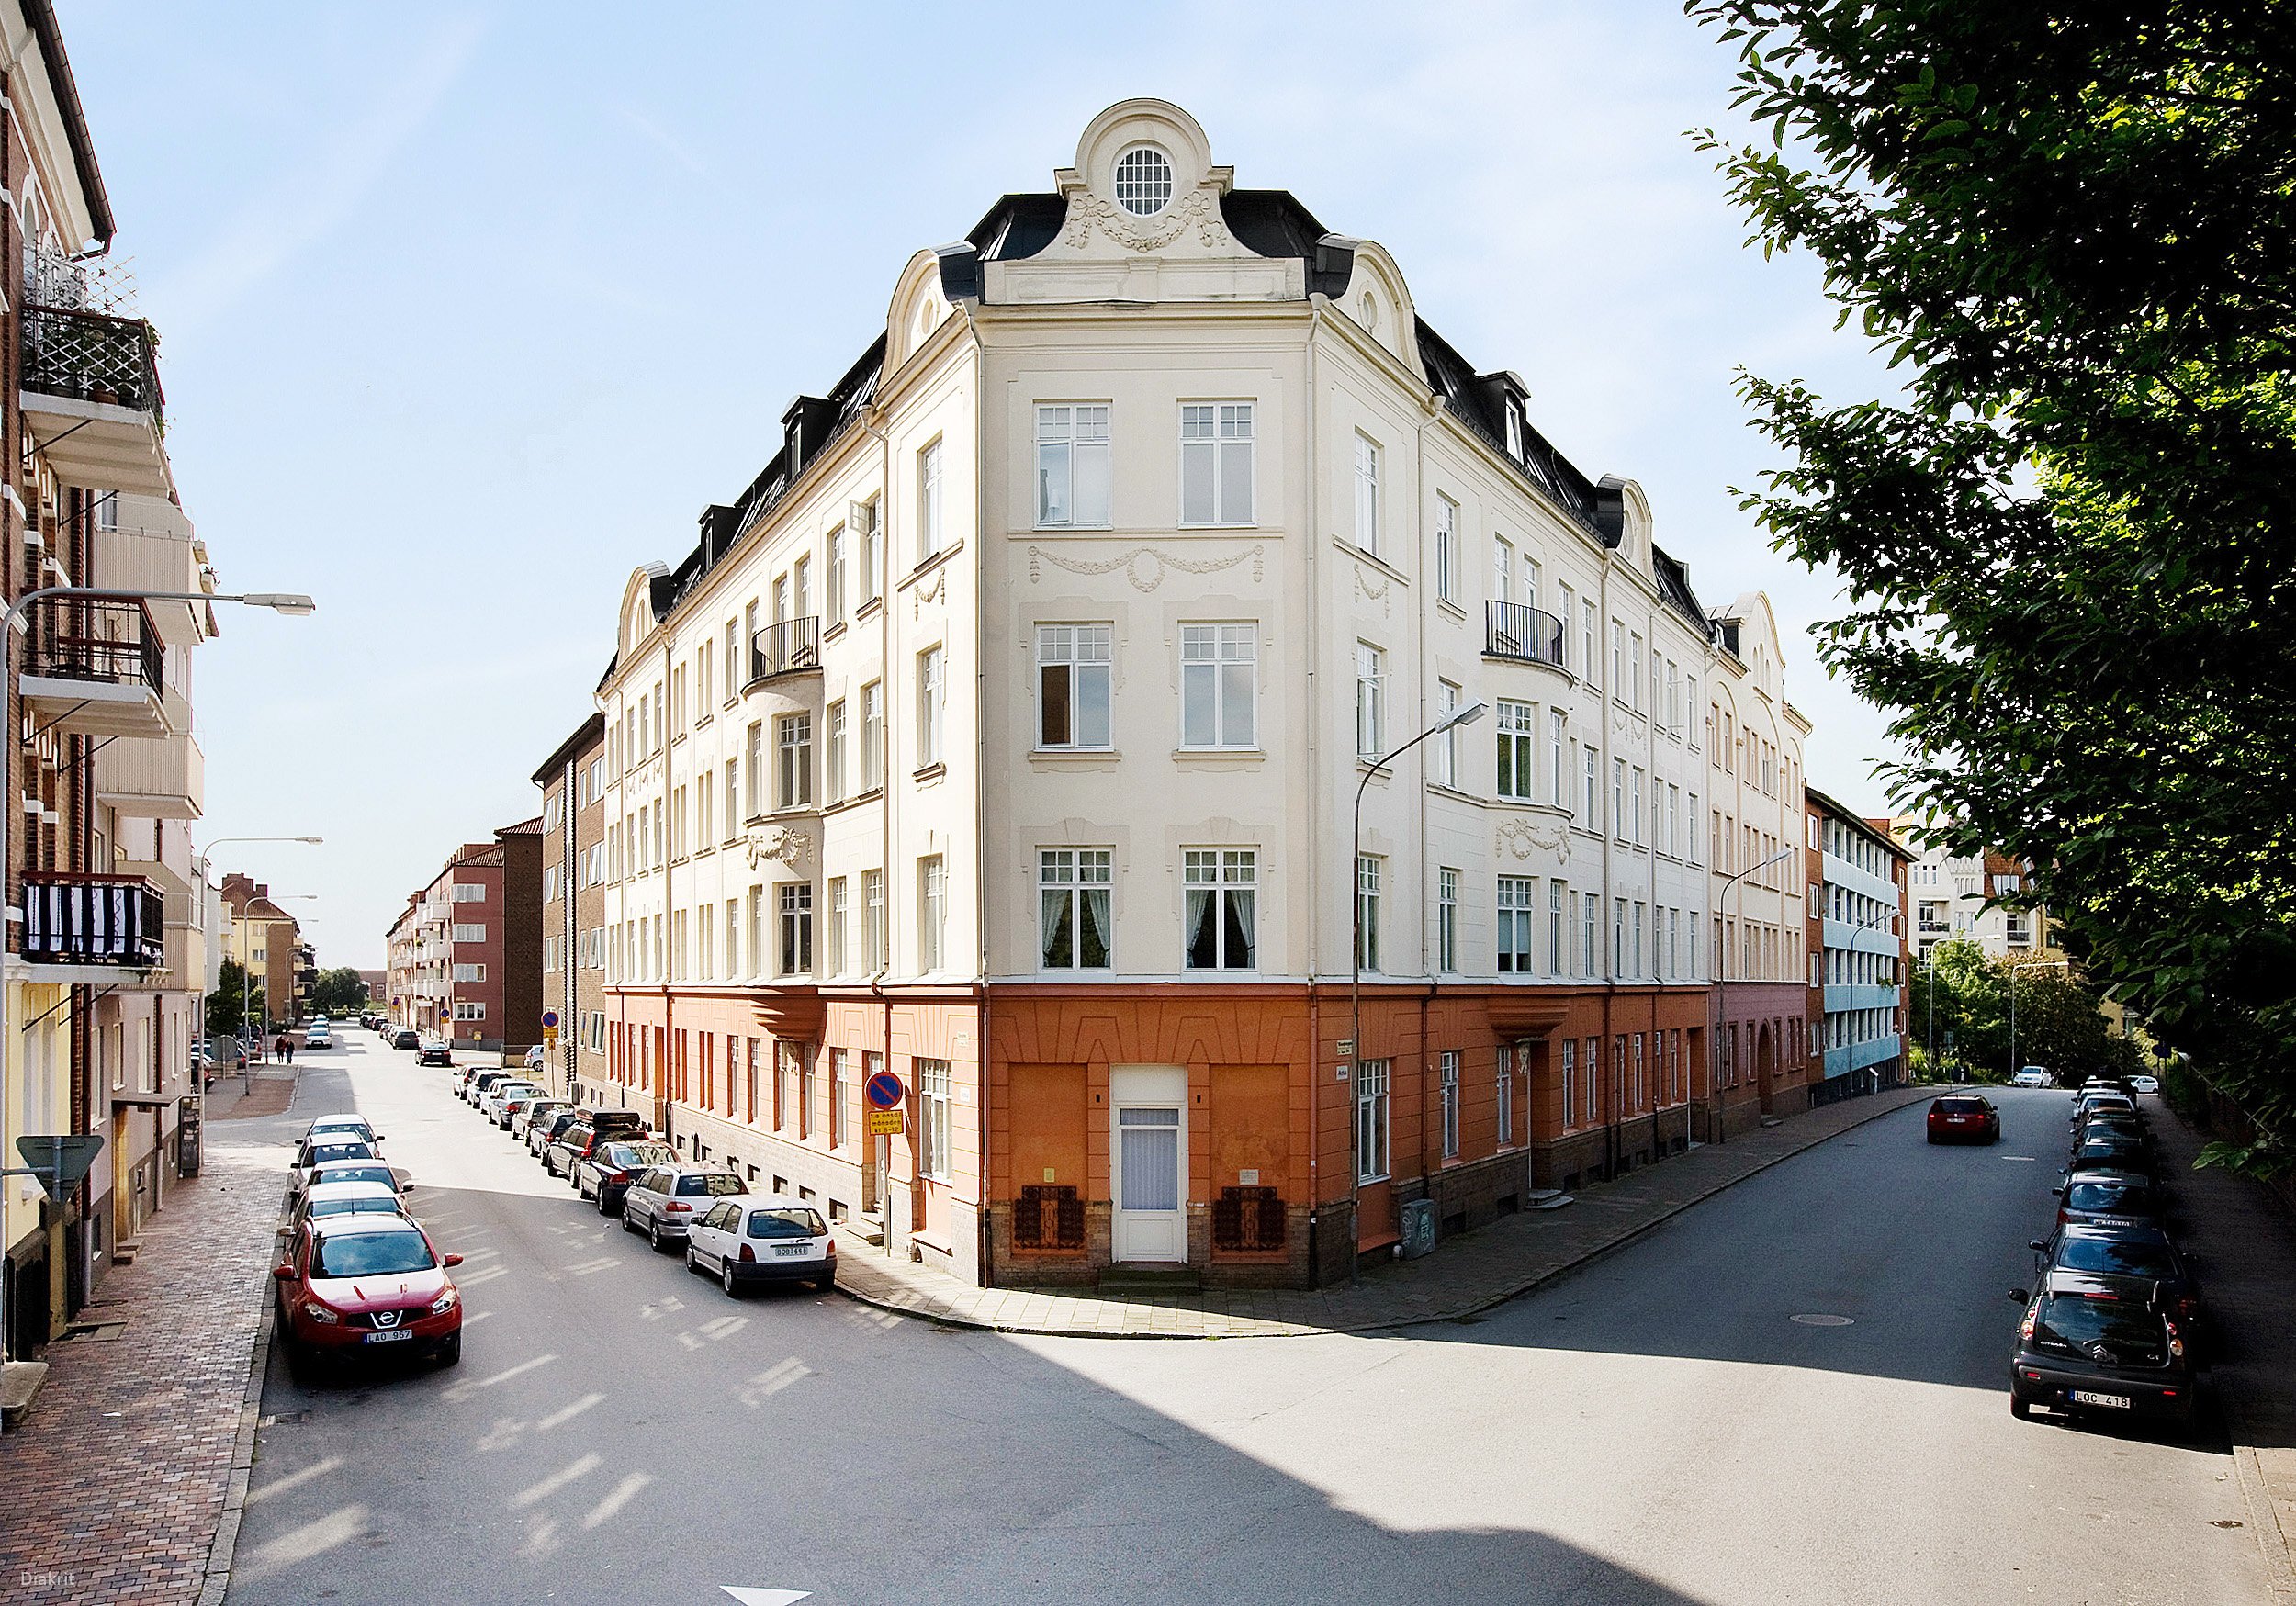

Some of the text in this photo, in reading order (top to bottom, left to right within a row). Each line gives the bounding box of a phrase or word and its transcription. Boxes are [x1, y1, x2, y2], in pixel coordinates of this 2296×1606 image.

[392, 1330, 411, 1340] 967
[2076, 1392, 2128, 1407] LOC 418
